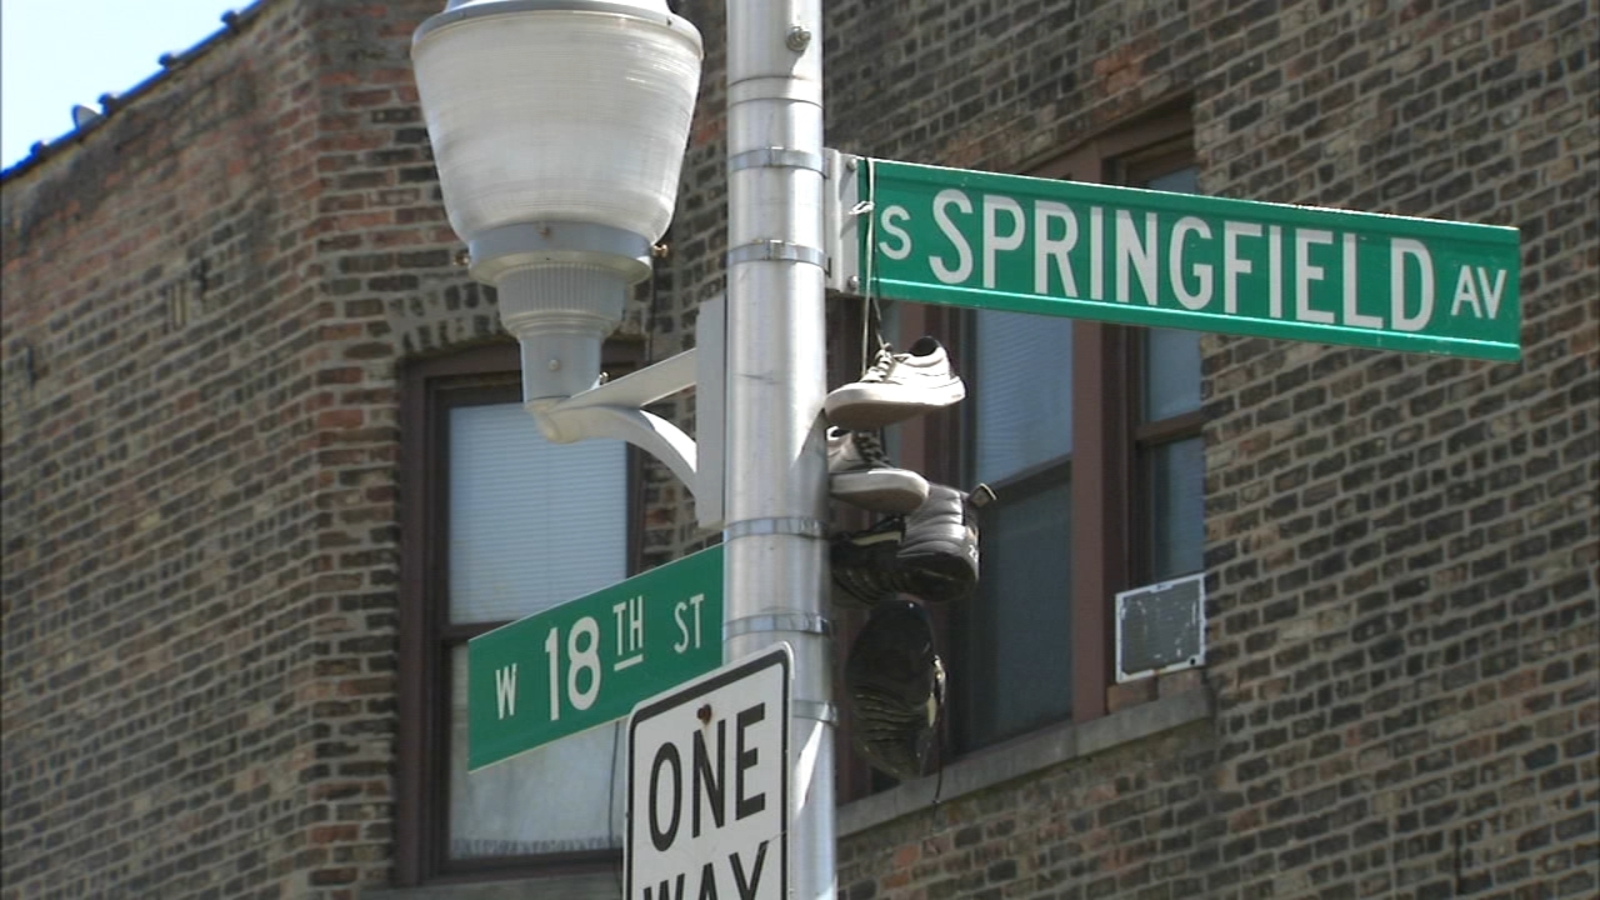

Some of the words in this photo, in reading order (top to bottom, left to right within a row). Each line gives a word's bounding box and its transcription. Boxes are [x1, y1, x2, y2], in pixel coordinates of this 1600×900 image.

[879, 204, 912, 261] S
[928, 188, 1435, 332] SPRINGFIELD
[1450, 264, 1507, 320] AV
[495, 663, 518, 721] W
[673, 593, 705, 654] ST
[649, 702, 766, 852] ONE
